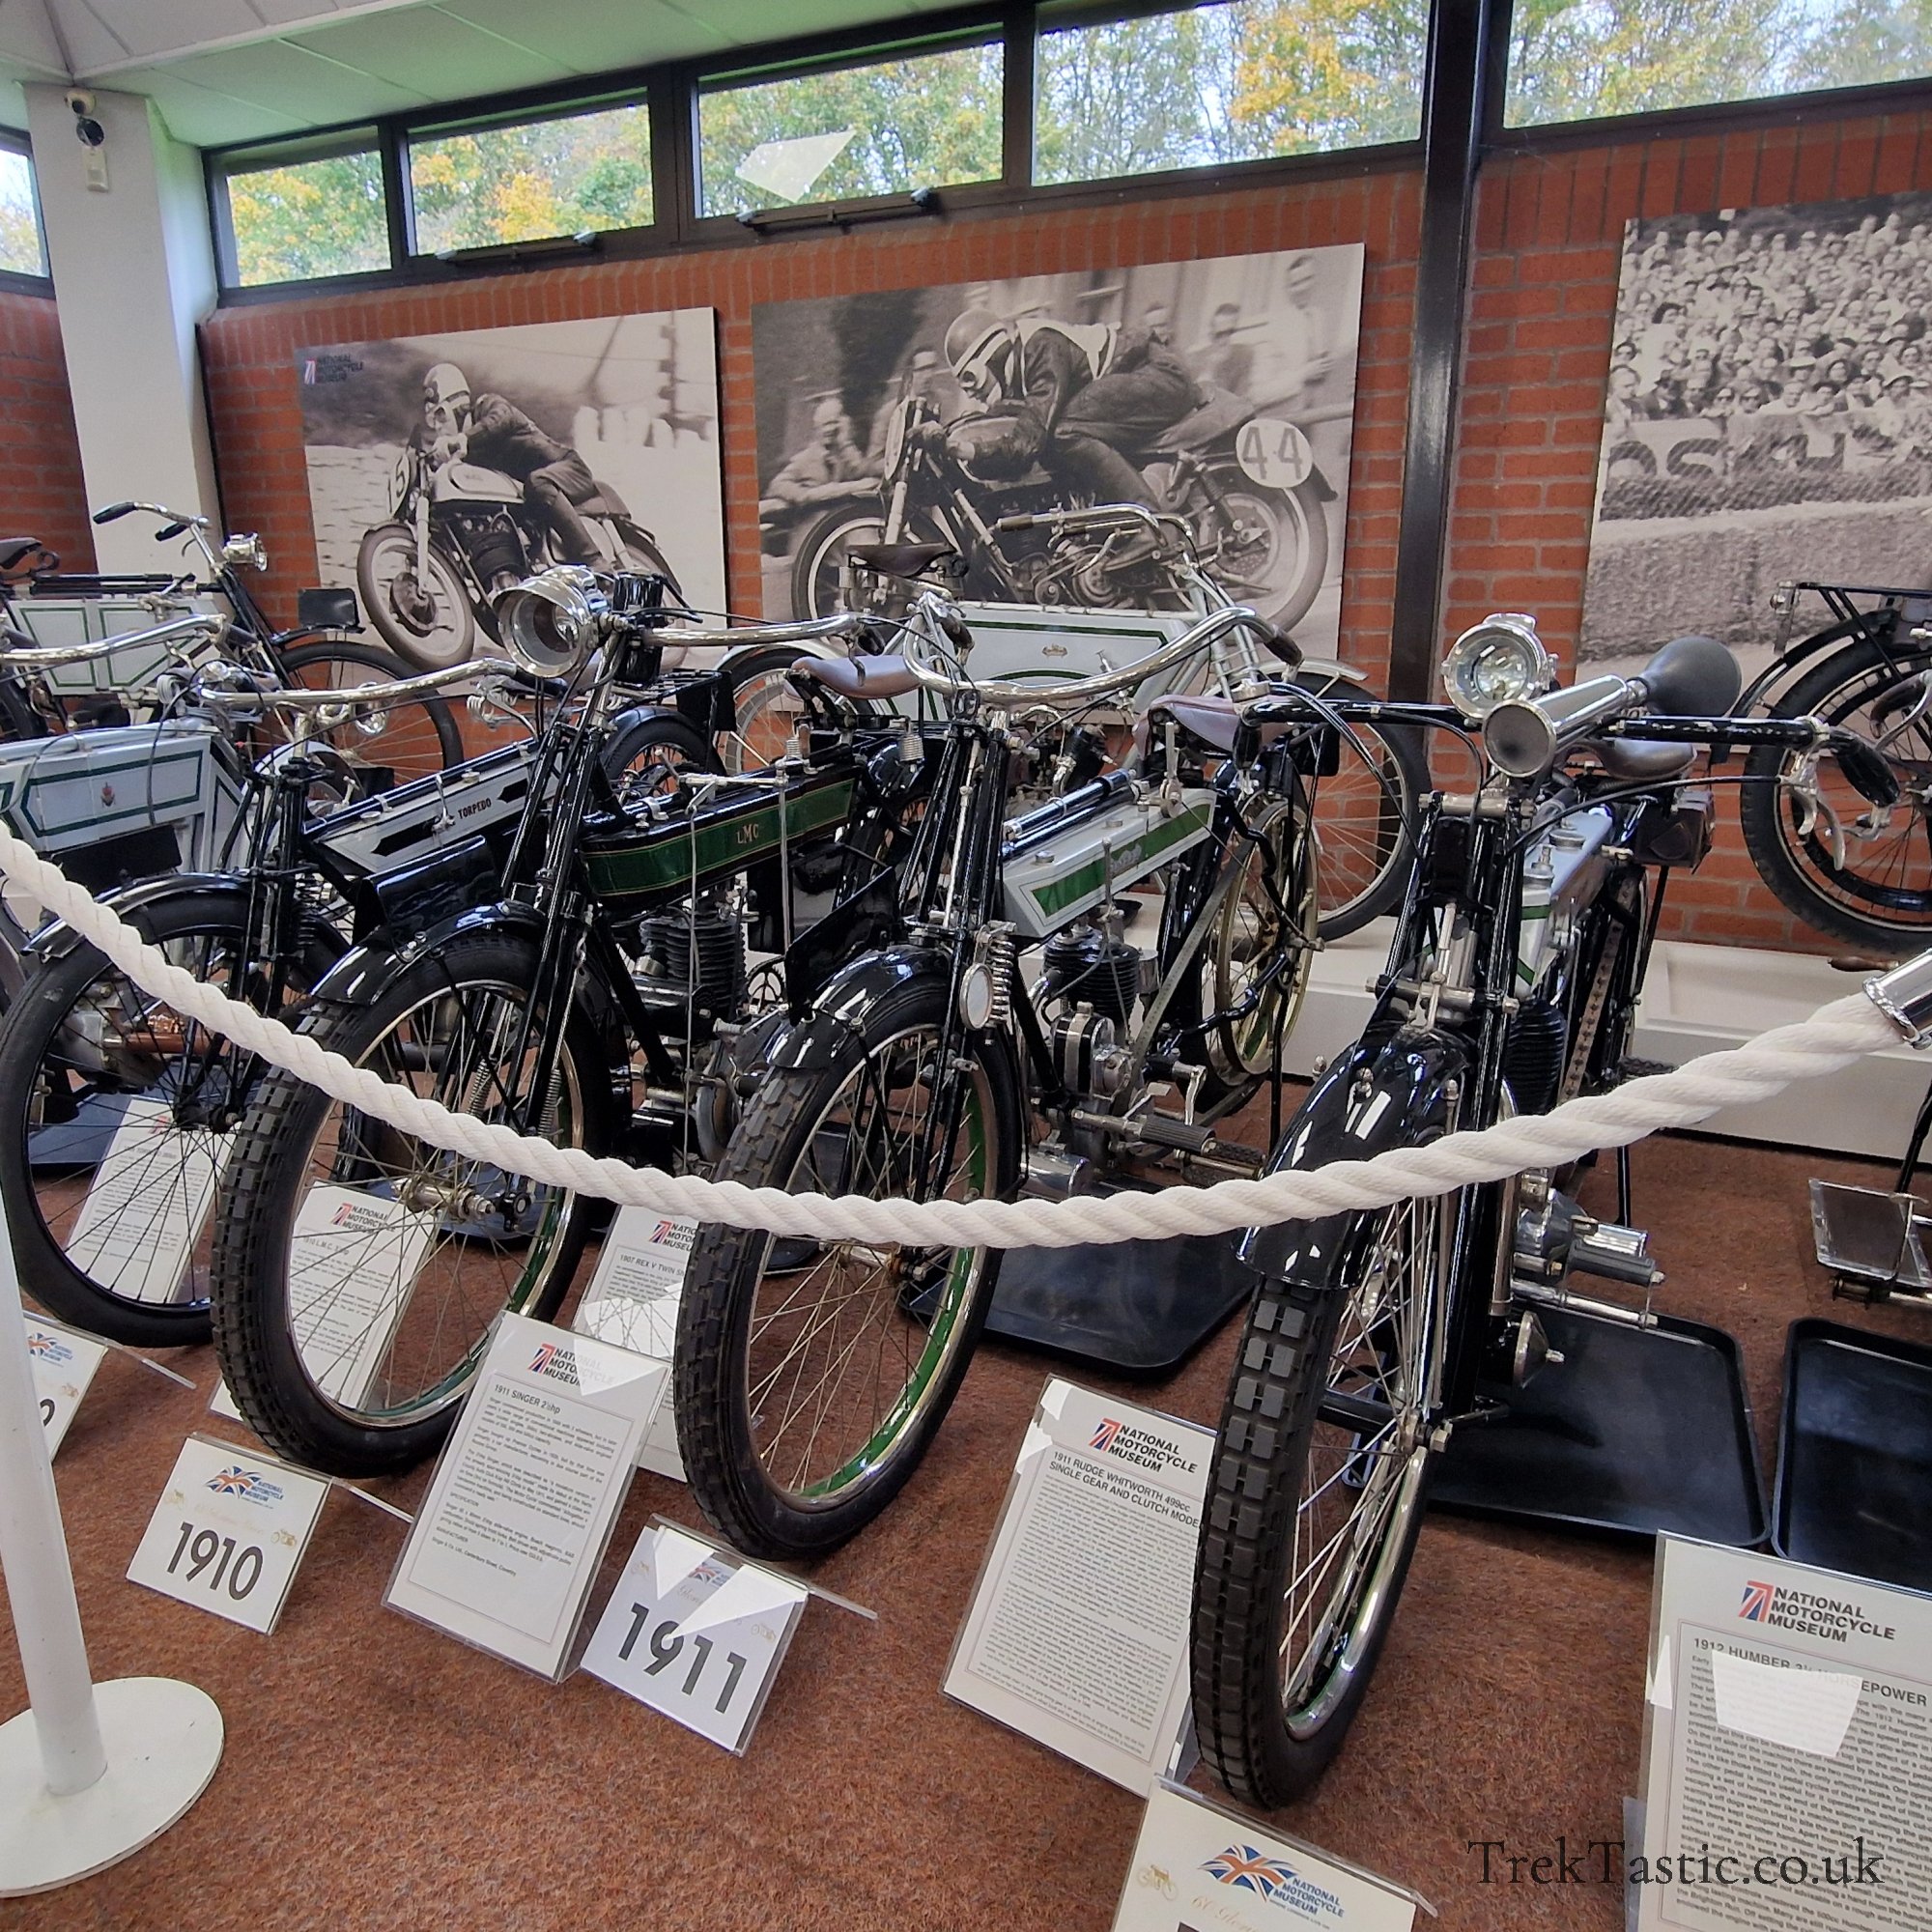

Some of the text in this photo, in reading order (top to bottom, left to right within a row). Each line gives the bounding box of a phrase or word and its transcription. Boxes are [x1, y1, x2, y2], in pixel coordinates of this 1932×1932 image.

[1242, 427, 1302, 479] 44
[458, 797, 492, 819] TORPEDO
[736, 823, 759, 844] LMC
[636, 1258, 649, 1267] REX
[495, 1383, 510, 1396] 1911
[511, 1390, 541, 1406] SINGER
[1115, 1435, 1198, 1474] MOTORCYCLE
[1119, 1425, 1180, 1455] NATIONAL
[1108, 1445, 1163, 1472] MUSEUM
[1049, 1461, 1201, 1528] SINGLE GEAR AND CLUTCH MODE
[1054, 1451, 1190, 1513] 1911 RUDGE WHITWORTH 499cc
[167, 1521, 263, 1600] 1910
[1775, 1587, 1864, 1619] NATIONAL
[1768, 1614, 1847, 1642] MUSEUM
[1771, 1601, 1895, 1640] MOTORCYCLE
[618, 1602, 748, 1714] 1911
[1729, 1646, 1790, 1668] HUMBER
[1273, 1889, 1319, 1915] MUSEUM
[1282, 1884, 1345, 1918] MOTORCYCLE
[1293, 1878, 1341, 1905] NATIONAL
